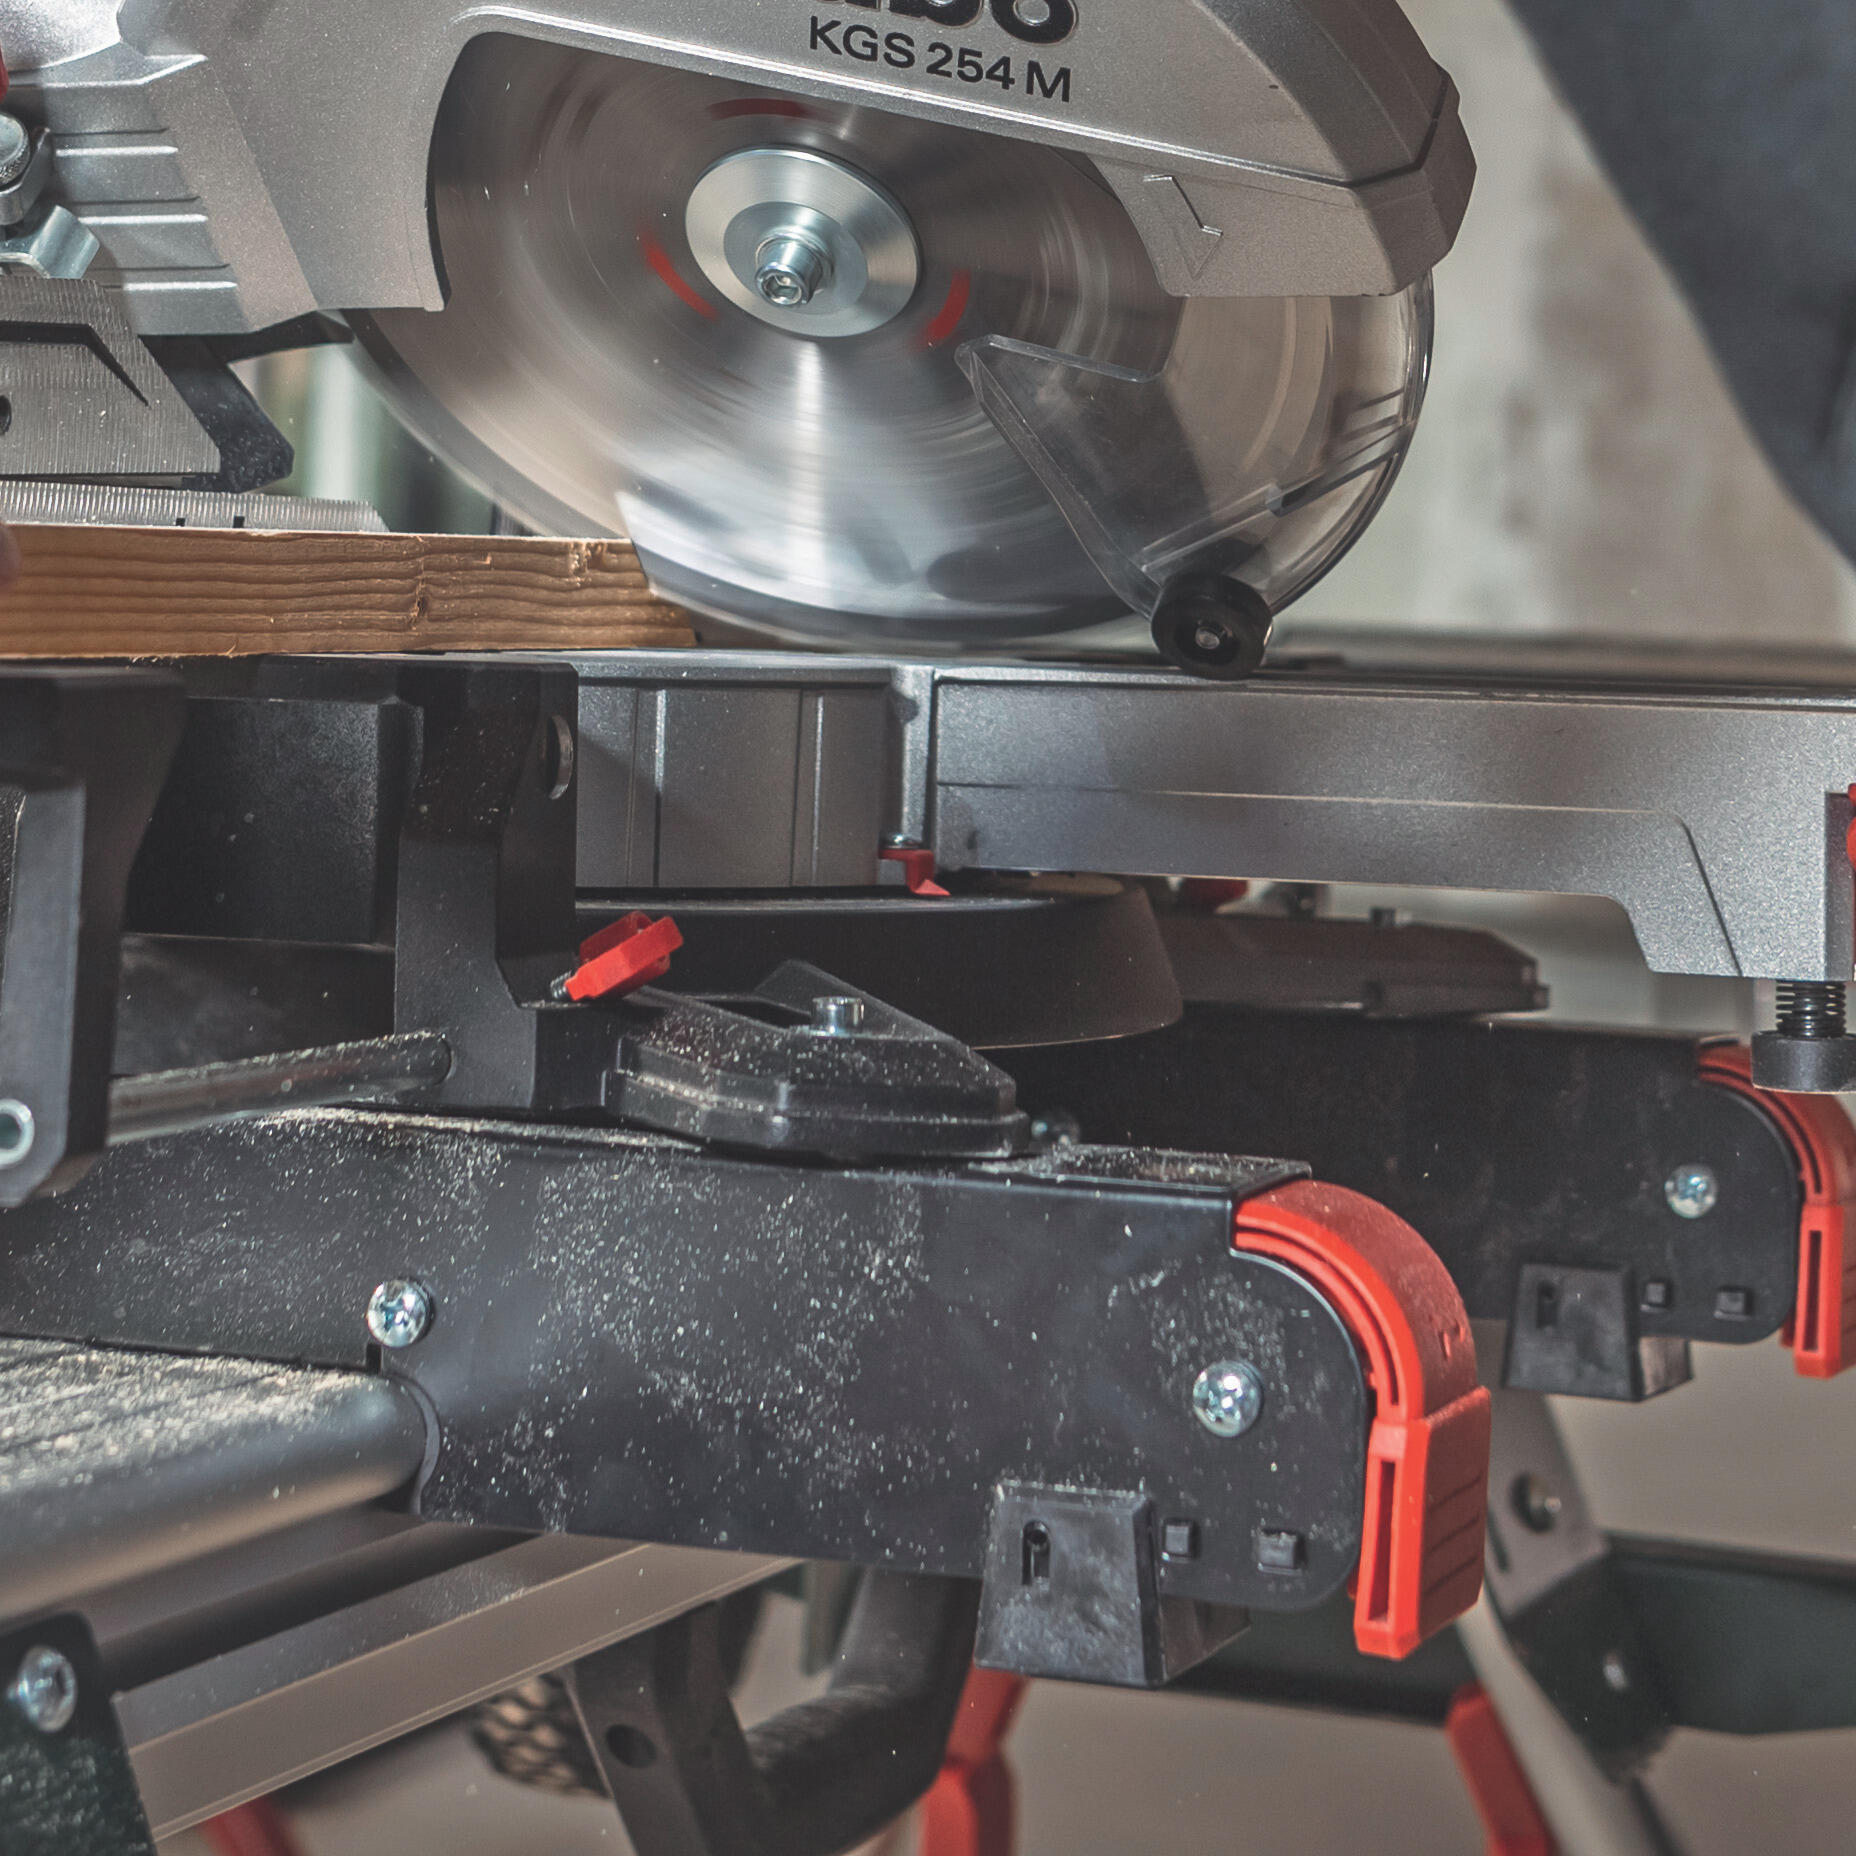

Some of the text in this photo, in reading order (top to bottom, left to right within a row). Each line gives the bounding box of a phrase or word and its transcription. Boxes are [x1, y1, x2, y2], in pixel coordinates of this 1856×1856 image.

[809, 15, 1071, 103] KGS 254 M
